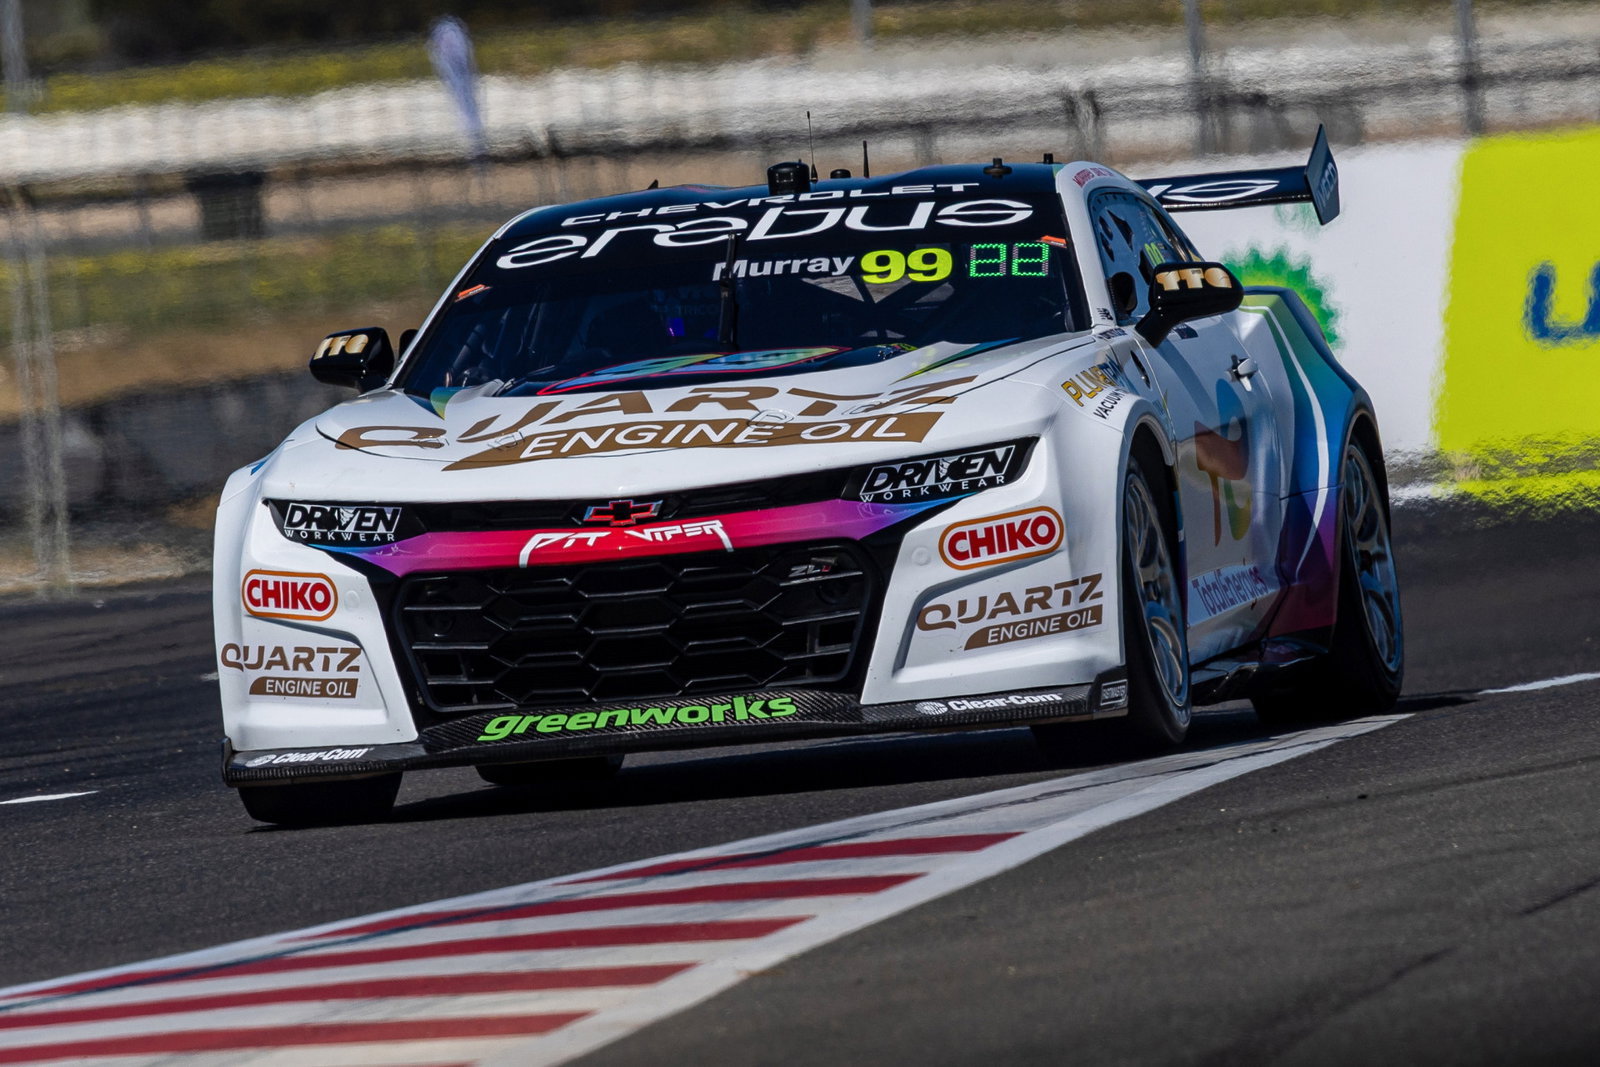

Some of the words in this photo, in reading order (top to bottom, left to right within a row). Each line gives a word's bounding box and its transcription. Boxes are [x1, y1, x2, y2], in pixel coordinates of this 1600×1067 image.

[560, 182, 980, 228] CHEVROLET
[496, 199, 1033, 269] erebus
[712, 256, 856, 282] Murray
[860, 248, 953, 284] 99
[334, 375, 979, 449] QUARTZ
[519, 421, 785, 459] ENGINE
[800, 417, 906, 441] OIL
[860, 445, 1015, 495] DRIVEN
[859, 475, 1005, 503] WORKWEAR
[284, 503, 402, 533] DRIVEN
[284, 529, 396, 542] WORKWEAR
[624, 520, 735, 552] VIPER
[947, 515, 1057, 561] CHIKO
[247, 579, 331, 612] CHIKO
[916, 572, 1104, 631] QUARTZ
[987, 616, 1062, 645] ENGINE
[1066, 609, 1097, 628] OIL
[220, 642, 362, 672] QUARTZ
[265, 679, 322, 695] ENGINE
[326, 680, 352, 696] OIL
[947, 692, 1062, 712] Clear-Com
[477, 697, 797, 741] greenworks
[272, 747, 370, 764] Clear-Com
